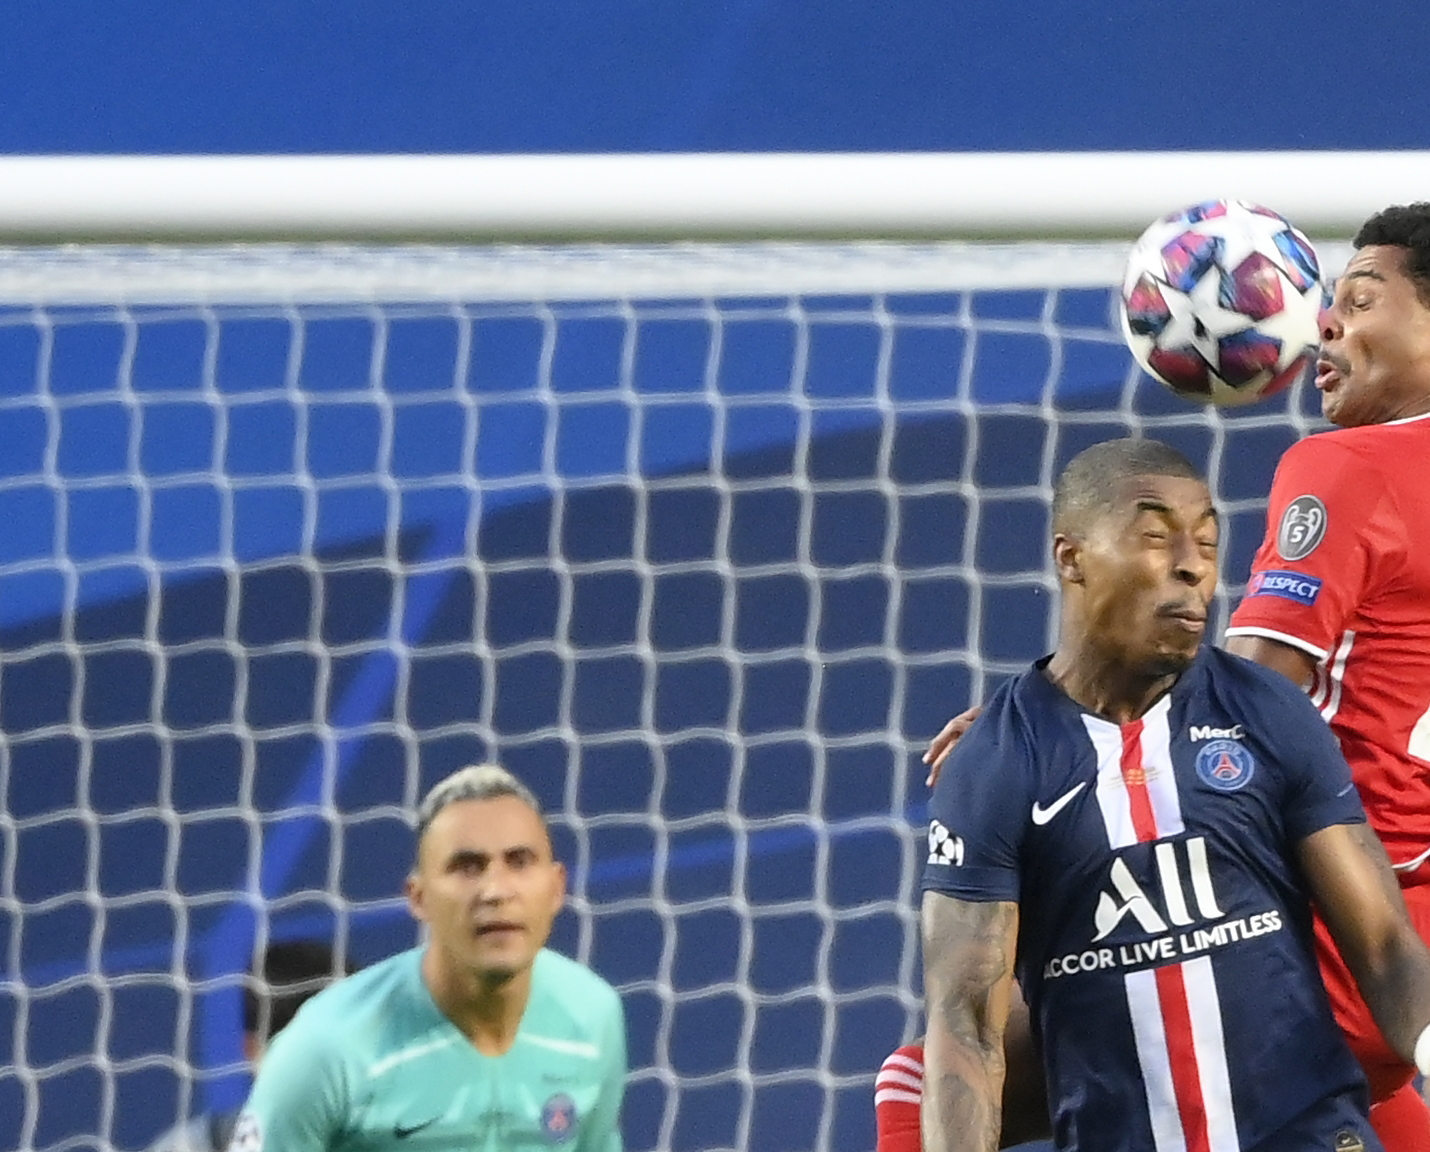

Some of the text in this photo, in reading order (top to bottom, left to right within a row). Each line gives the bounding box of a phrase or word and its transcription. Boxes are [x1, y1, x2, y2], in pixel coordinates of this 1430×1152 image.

[1290, 526, 1305, 543] 5
[1262, 576, 1319, 598] RESPECT
[1120, 936, 1176, 966] LIVE
[1180, 910, 1283, 955] LIMITLESS
